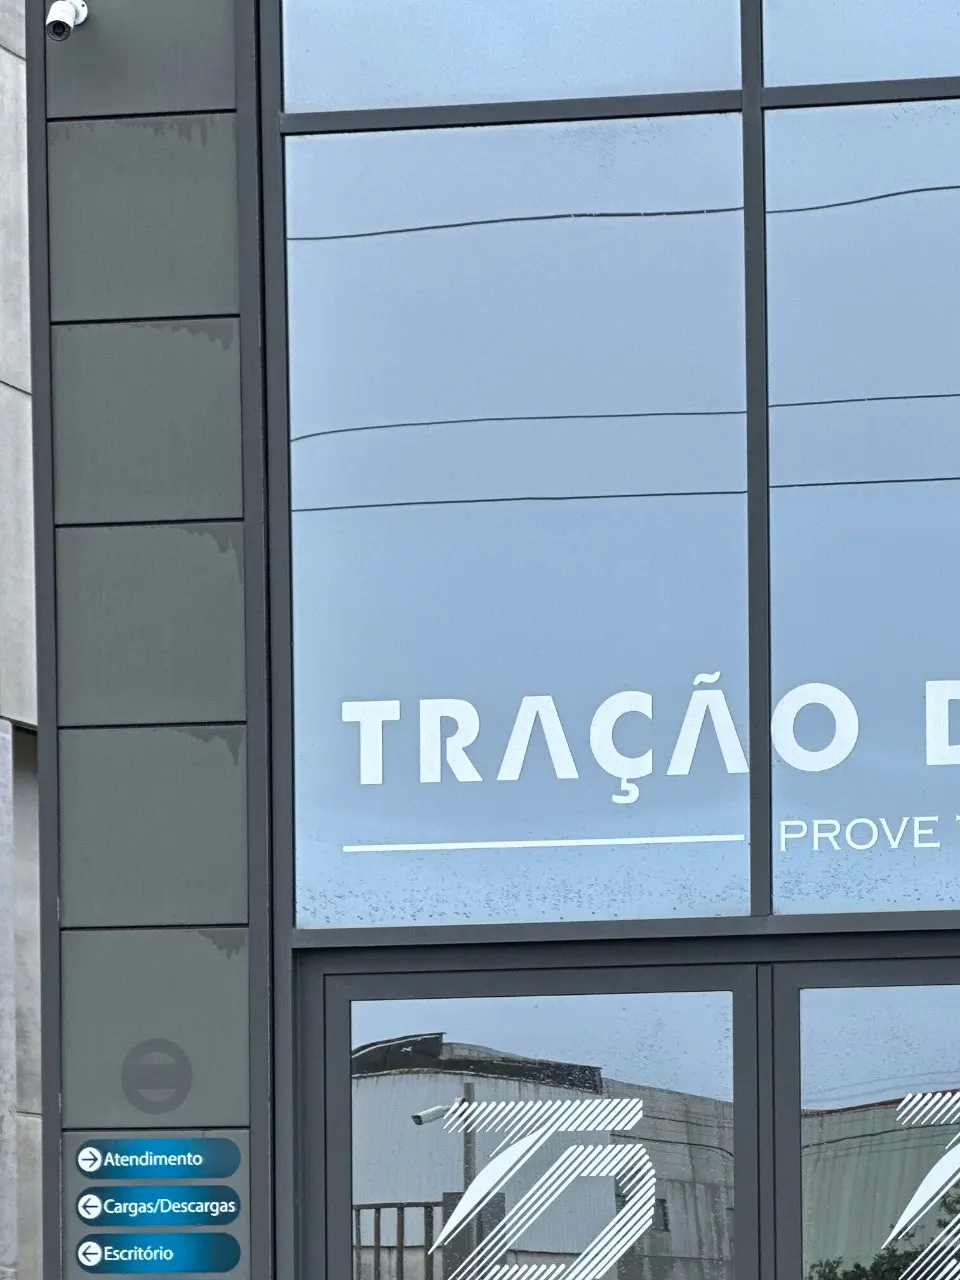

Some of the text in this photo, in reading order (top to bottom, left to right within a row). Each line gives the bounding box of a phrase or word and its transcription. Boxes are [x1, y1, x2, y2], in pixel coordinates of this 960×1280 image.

[341, 671, 860, 804] TRAÇÃO
[779, 816, 941, 852] PROVE
[104, 1151, 203, 1166] Atendimento
[104, 1199, 236, 1216] Cargas/Descargas
[104, 1246, 174, 1260] Escritório
